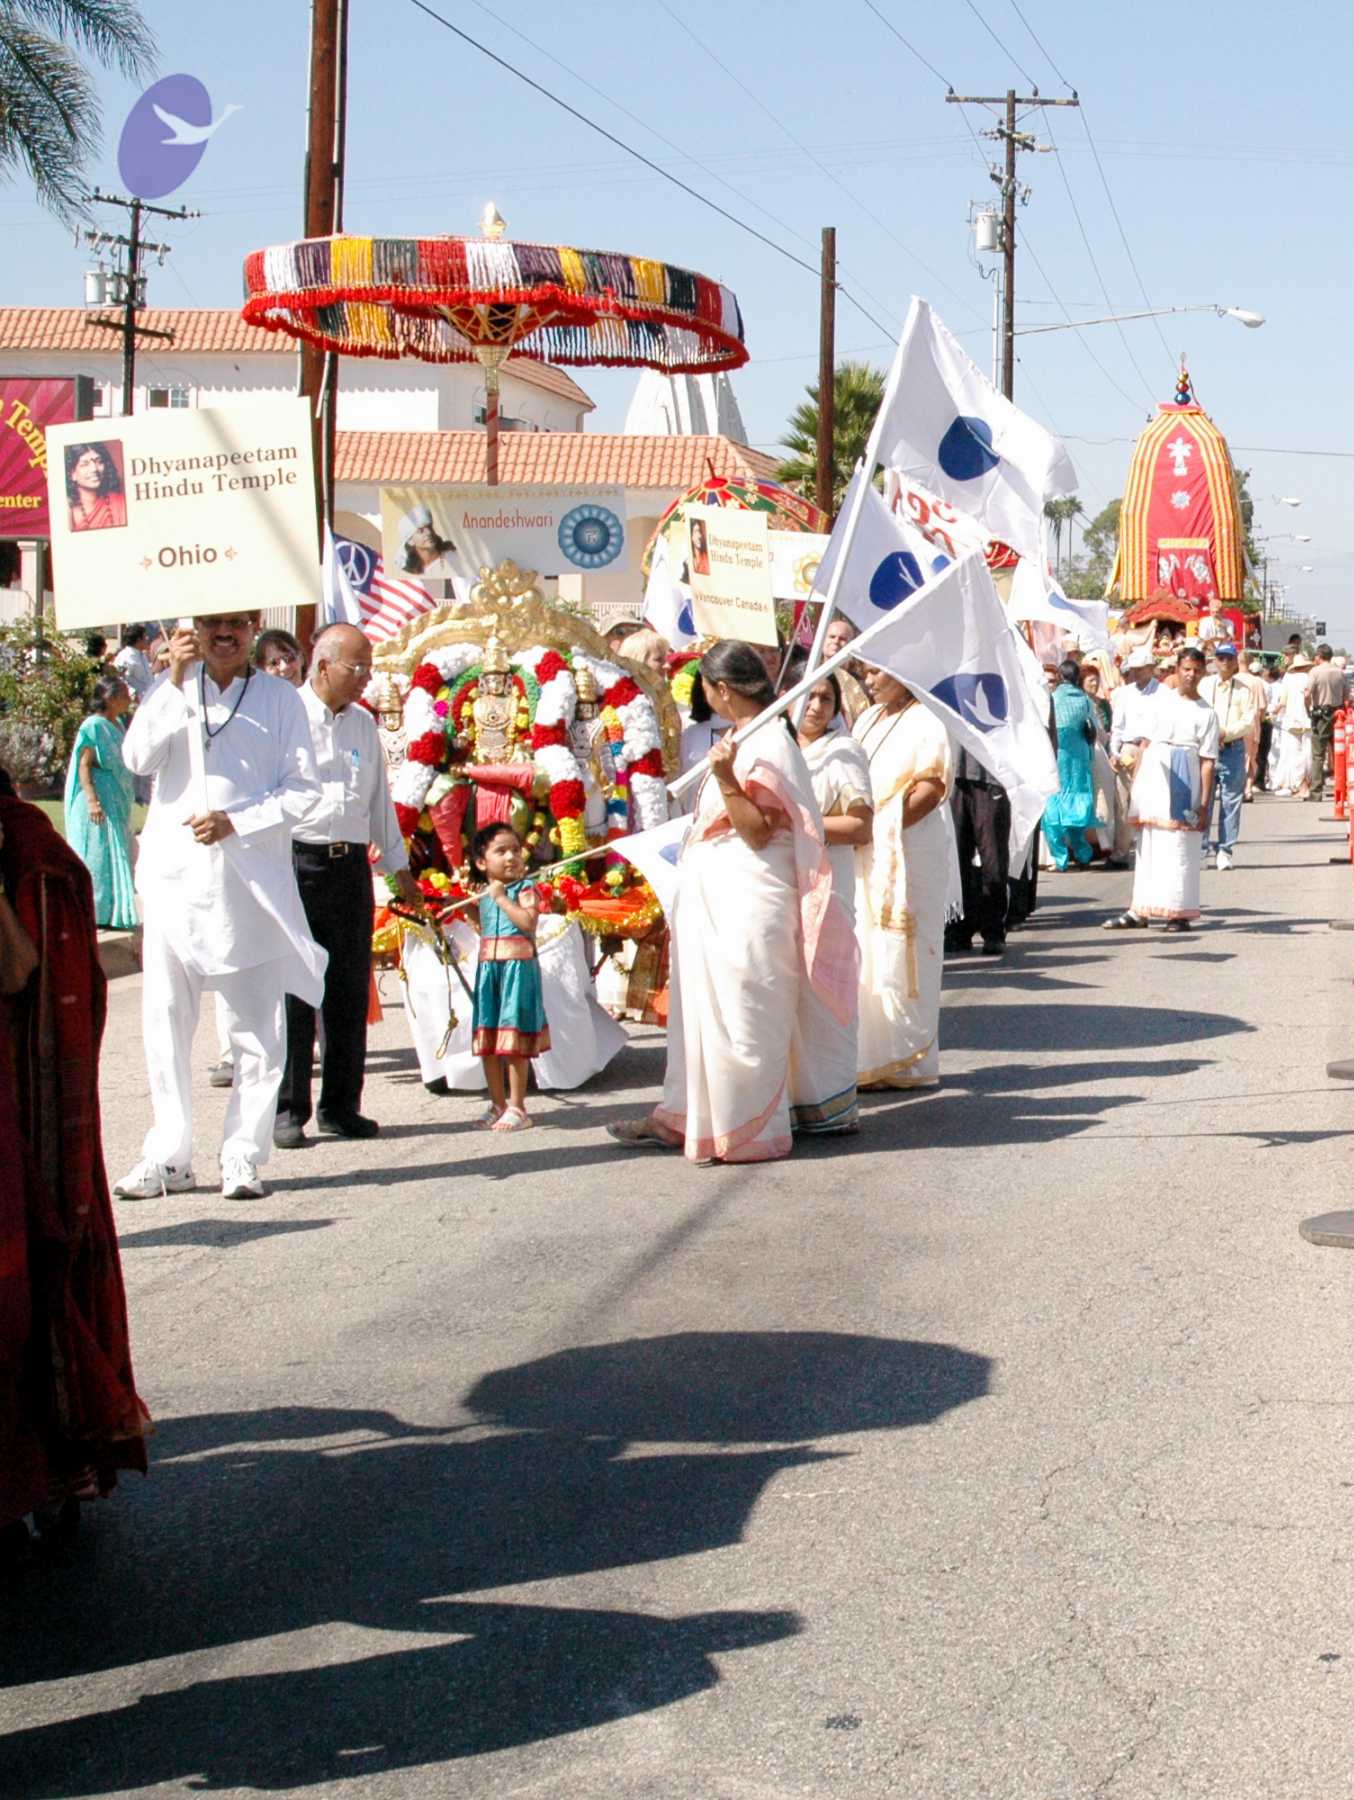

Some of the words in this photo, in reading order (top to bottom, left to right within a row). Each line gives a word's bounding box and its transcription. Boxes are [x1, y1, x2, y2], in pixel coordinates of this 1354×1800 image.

[5, 399, 49, 479] Temp
[130, 446, 298, 478] Dhyanapeetam
[134, 478, 203, 501] Hindu
[211, 467, 297, 491] Temple
[0, 493, 41, 508] enter
[462, 508, 553, 529] Anandeshwari
[158, 544, 218, 568] Ohio
